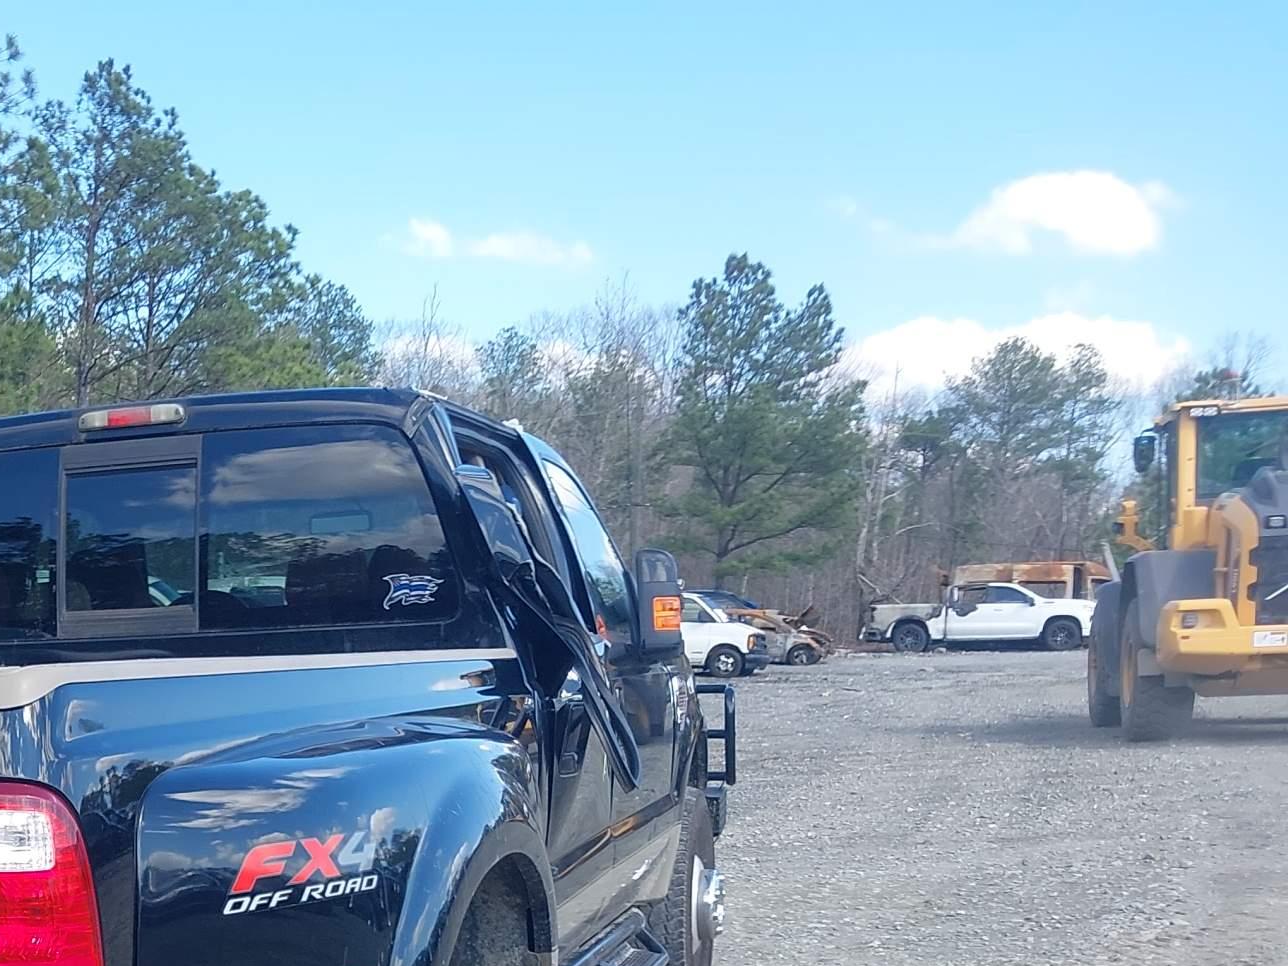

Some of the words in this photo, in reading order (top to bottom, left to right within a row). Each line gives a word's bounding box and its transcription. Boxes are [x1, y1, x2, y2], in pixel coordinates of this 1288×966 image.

[229, 830, 377, 895] FX4
[223, 888, 293, 915] OFF
[300, 875, 378, 903] ROAD
